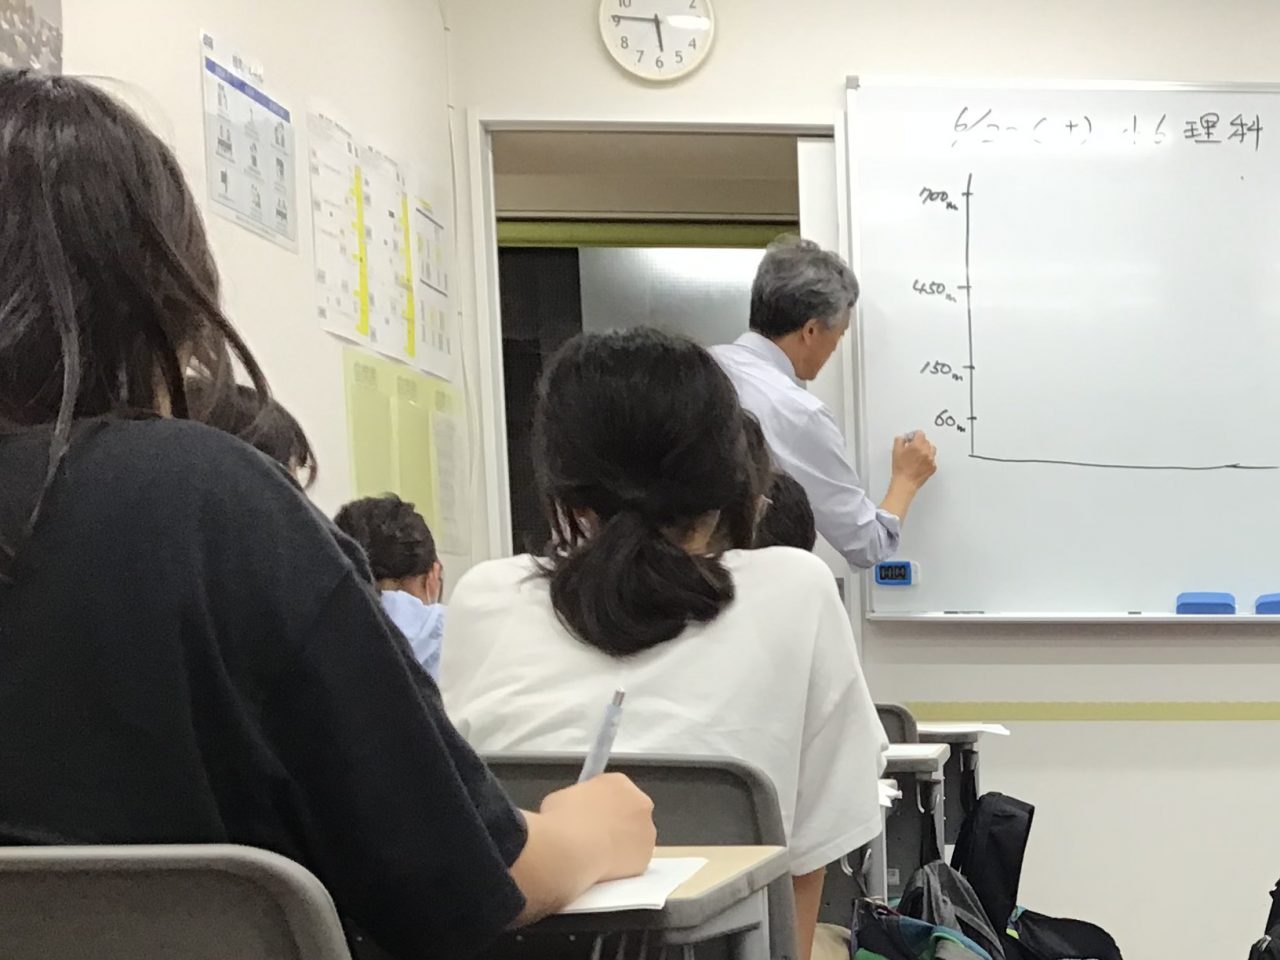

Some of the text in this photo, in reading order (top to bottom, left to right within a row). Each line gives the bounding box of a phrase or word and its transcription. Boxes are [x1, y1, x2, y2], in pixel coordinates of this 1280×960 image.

[620, 36, 629, 49] 8
[687, 38, 697, 50] 4
[635, 50, 644, 63] 7
[655, 56, 664, 69] 6
[674, 51, 683, 63] 5
